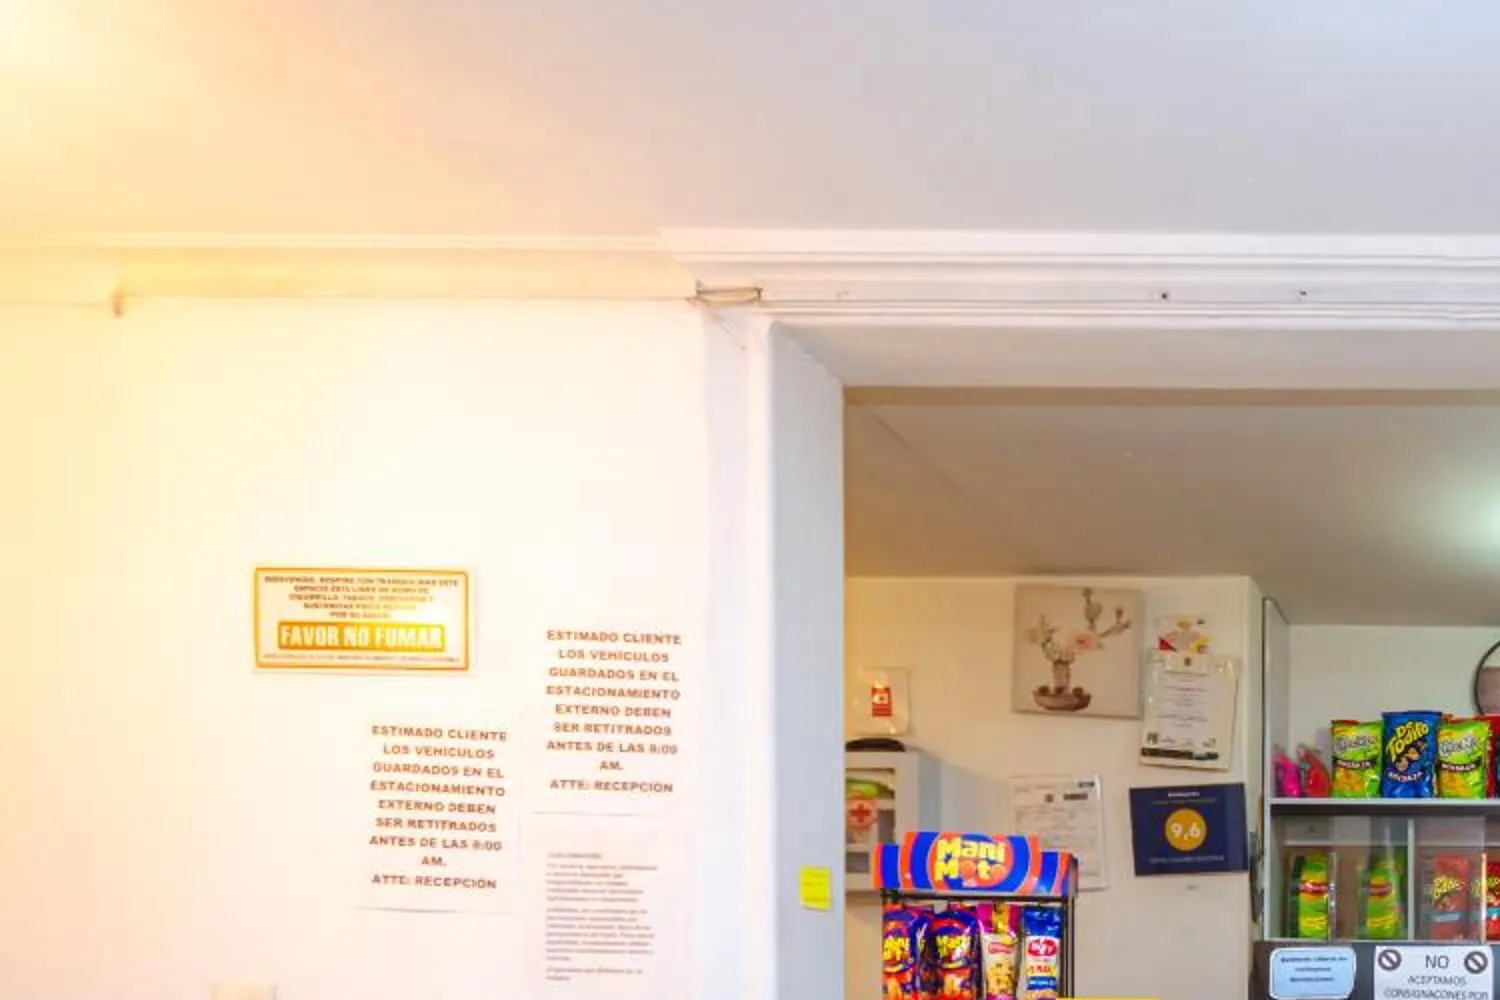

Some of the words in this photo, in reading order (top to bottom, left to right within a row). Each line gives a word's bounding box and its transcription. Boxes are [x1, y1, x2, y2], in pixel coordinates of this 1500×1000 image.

[281, 625, 339, 646] FAVOR
[344, 626, 369, 647] NO
[376, 627, 444, 649] FUMAR
[547, 630, 618, 641] ESTIMADO
[623, 634, 681, 645] CLIENTE
[558, 649, 585, 659] LOS
[548, 668, 634, 679] GUARDADOS
[640, 670, 656, 680] EN
[662, 671, 678, 682] EL
[546, 685, 680, 700] ESTACIONAMIENTO
[555, 704, 620, 715] EXTERNO
[625, 707, 671, 718] DEBEN
[372, 726, 443, 738] ESTIMADO
[448, 729, 507, 741] CLIENTE
[553, 722, 580, 732] SER
[383, 744, 409, 754] LOS
[546, 741, 592, 750] ANTES
[597, 742, 613, 752] DE
[619, 743, 644, 753] LAS
[373, 763, 458, 775] GUARDADOS
[463, 767, 481, 776] EN
[487, 768, 504, 778] EL
[371, 781, 505, 797] ESTACIONAMIENTO
[550, 780, 590, 789] ATTE:
[379, 800, 444, 812] EXTERNO
[448, 802, 496, 814] DEBEN
[376, 818, 402, 828] SER
[1171, 822, 1200, 840] 9,6
[370, 836, 415, 846] ANTES
[420, 838, 437, 847] DE
[442, 839, 468, 849] LAS
[372, 875, 409, 884] ATTE:
[1425, 955, 1450, 969] NO
[1407, 975, 1467, 986] ACEPTAMOS
[1468, 990, 1489, 1000] POR
